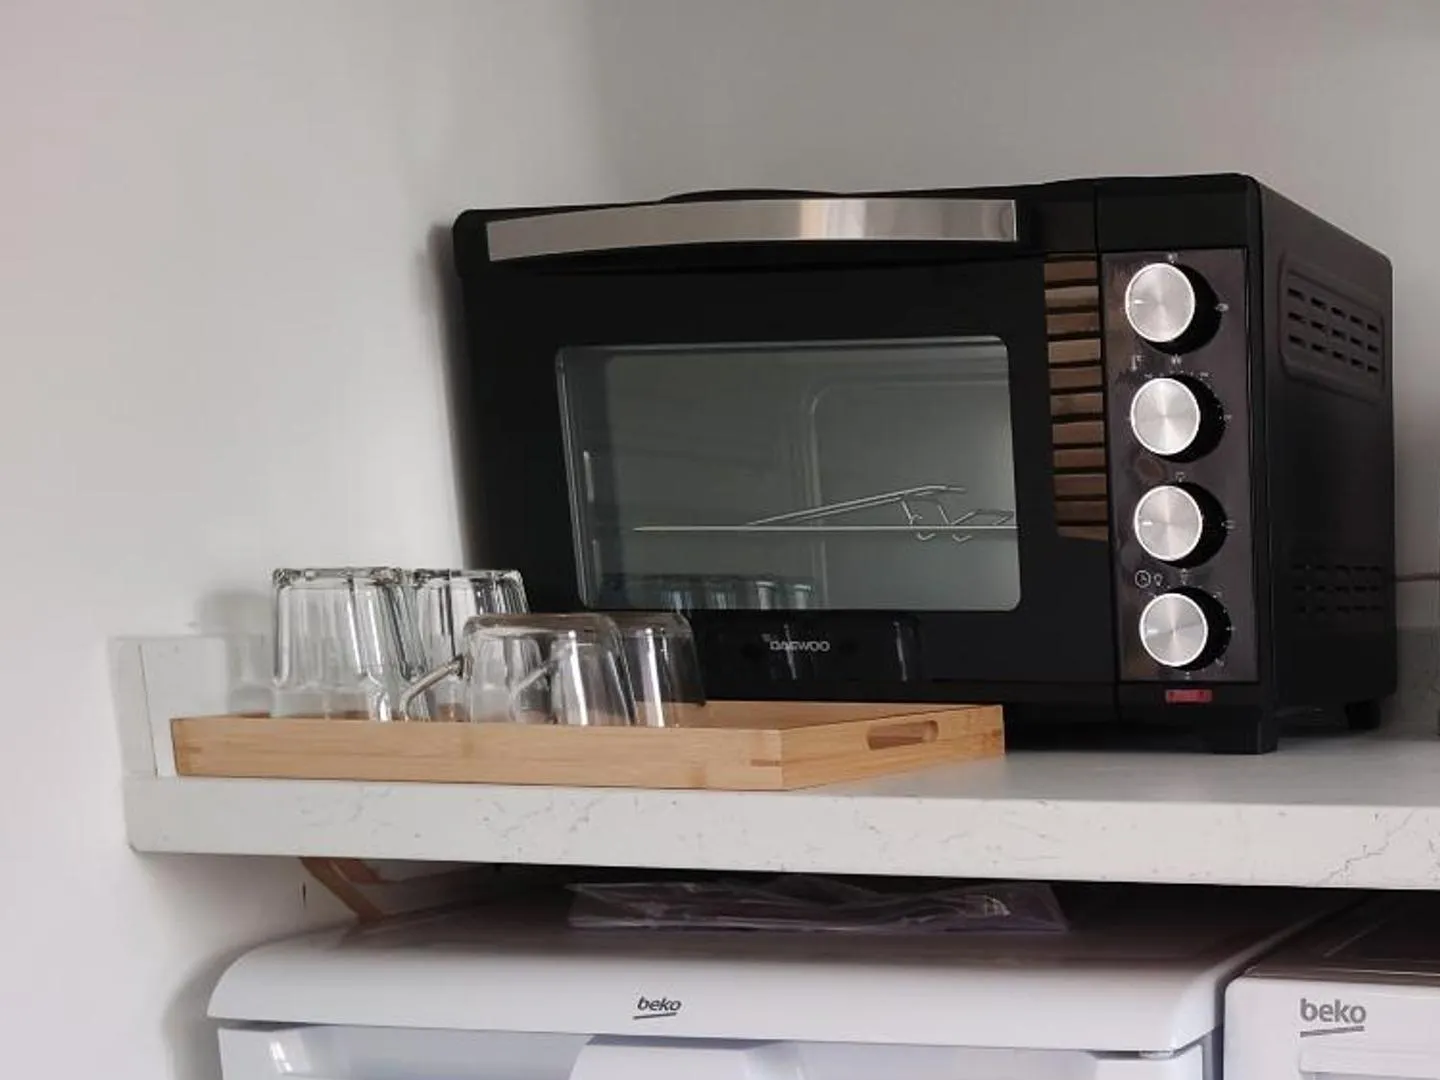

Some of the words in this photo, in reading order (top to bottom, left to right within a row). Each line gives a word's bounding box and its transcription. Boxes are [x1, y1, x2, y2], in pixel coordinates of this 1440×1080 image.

[769, 640, 831, 652] DAEWOO
[637, 996, 682, 1011] beko
[1300, 998, 1367, 1024] beko
